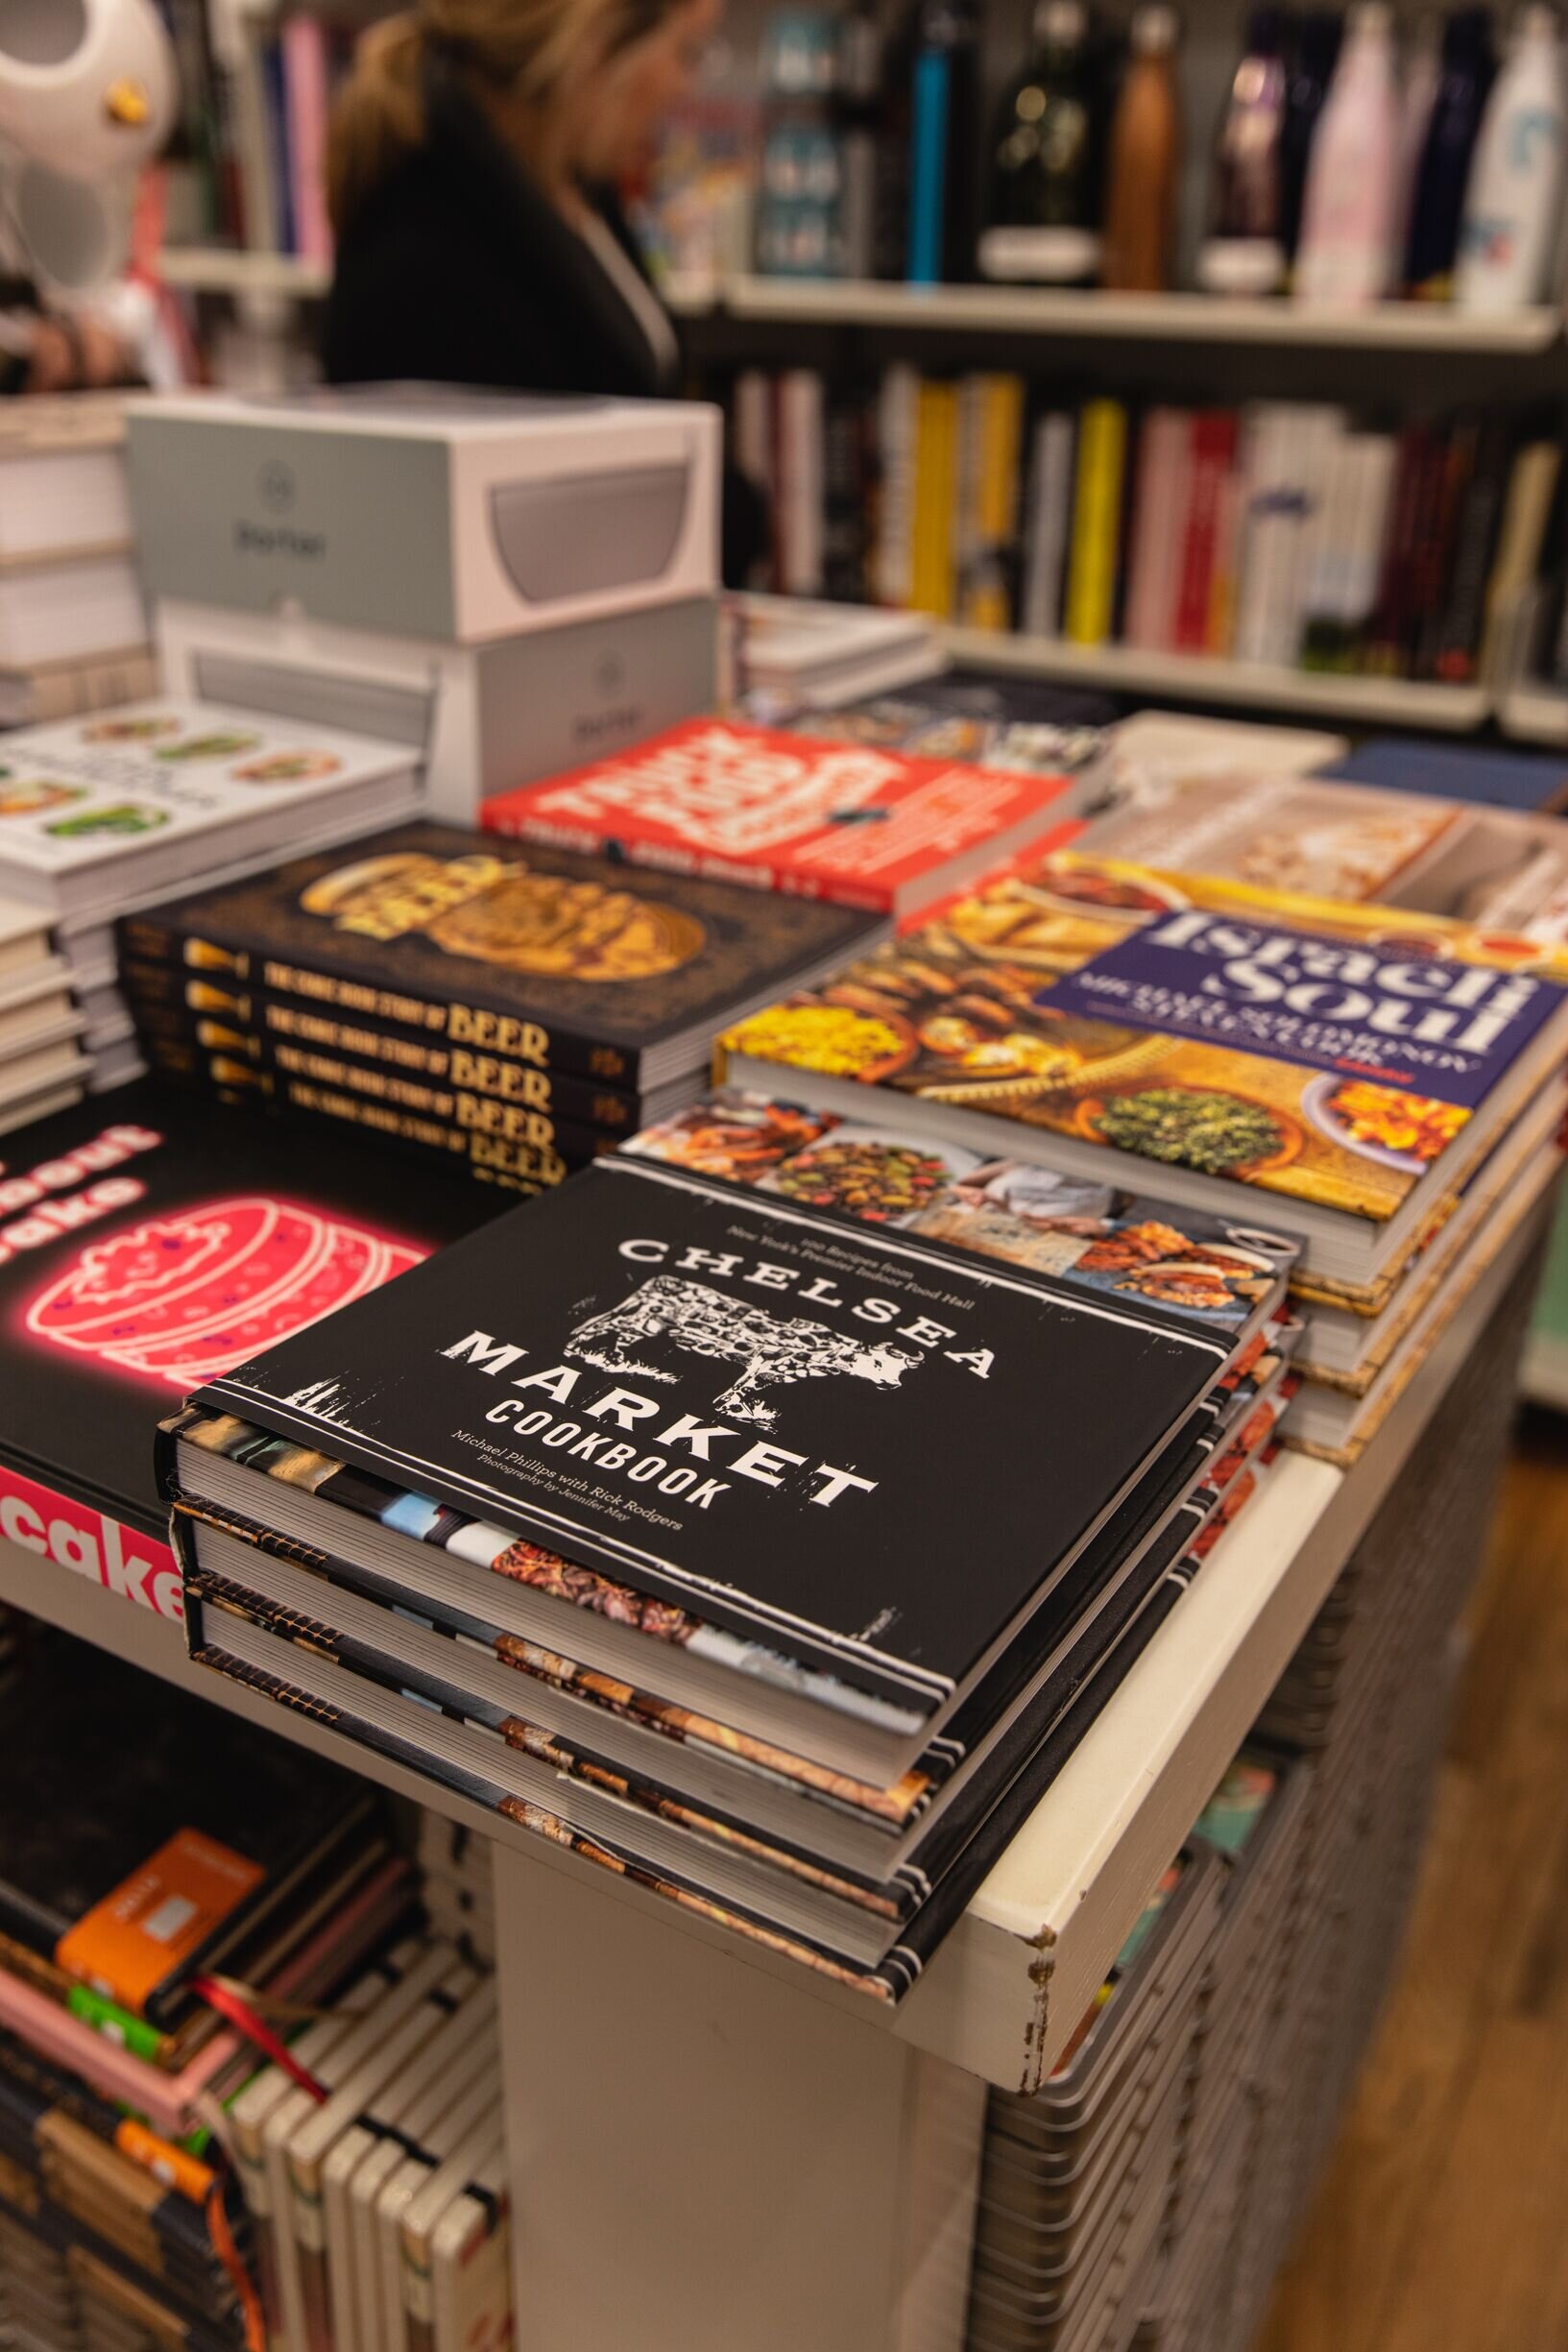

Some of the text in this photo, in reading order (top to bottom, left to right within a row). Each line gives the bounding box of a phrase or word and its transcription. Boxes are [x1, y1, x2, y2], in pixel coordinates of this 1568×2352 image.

[1149, 909, 1539, 1018] Israeli
[1200, 956, 1525, 1055] Soul
[447, 1003, 550, 1067] BEER
[450, 1048, 552, 1114] BEER
[456, 1091, 555, 1152] BEER
[617, 1237, 995, 1379] CHELSEA
[726, 1224, 757, 1243] New
[799, 1247, 855, 1273] Premier
[855, 1264, 903, 1290] Indoor
[903, 1280, 942, 1301] Food
[943, 1291, 976, 1311] Hall
[826, 1245, 879, 1270] Recipes
[880, 1259, 915, 1280] from
[439, 1329, 880, 1508] MARKET
[485, 1399, 732, 1510] COOKBOOK
[451, 1429, 684, 1532] Michael Phillips with Rick Rodgers
[477, 1453, 630, 1522] Photography by Jennifer May
